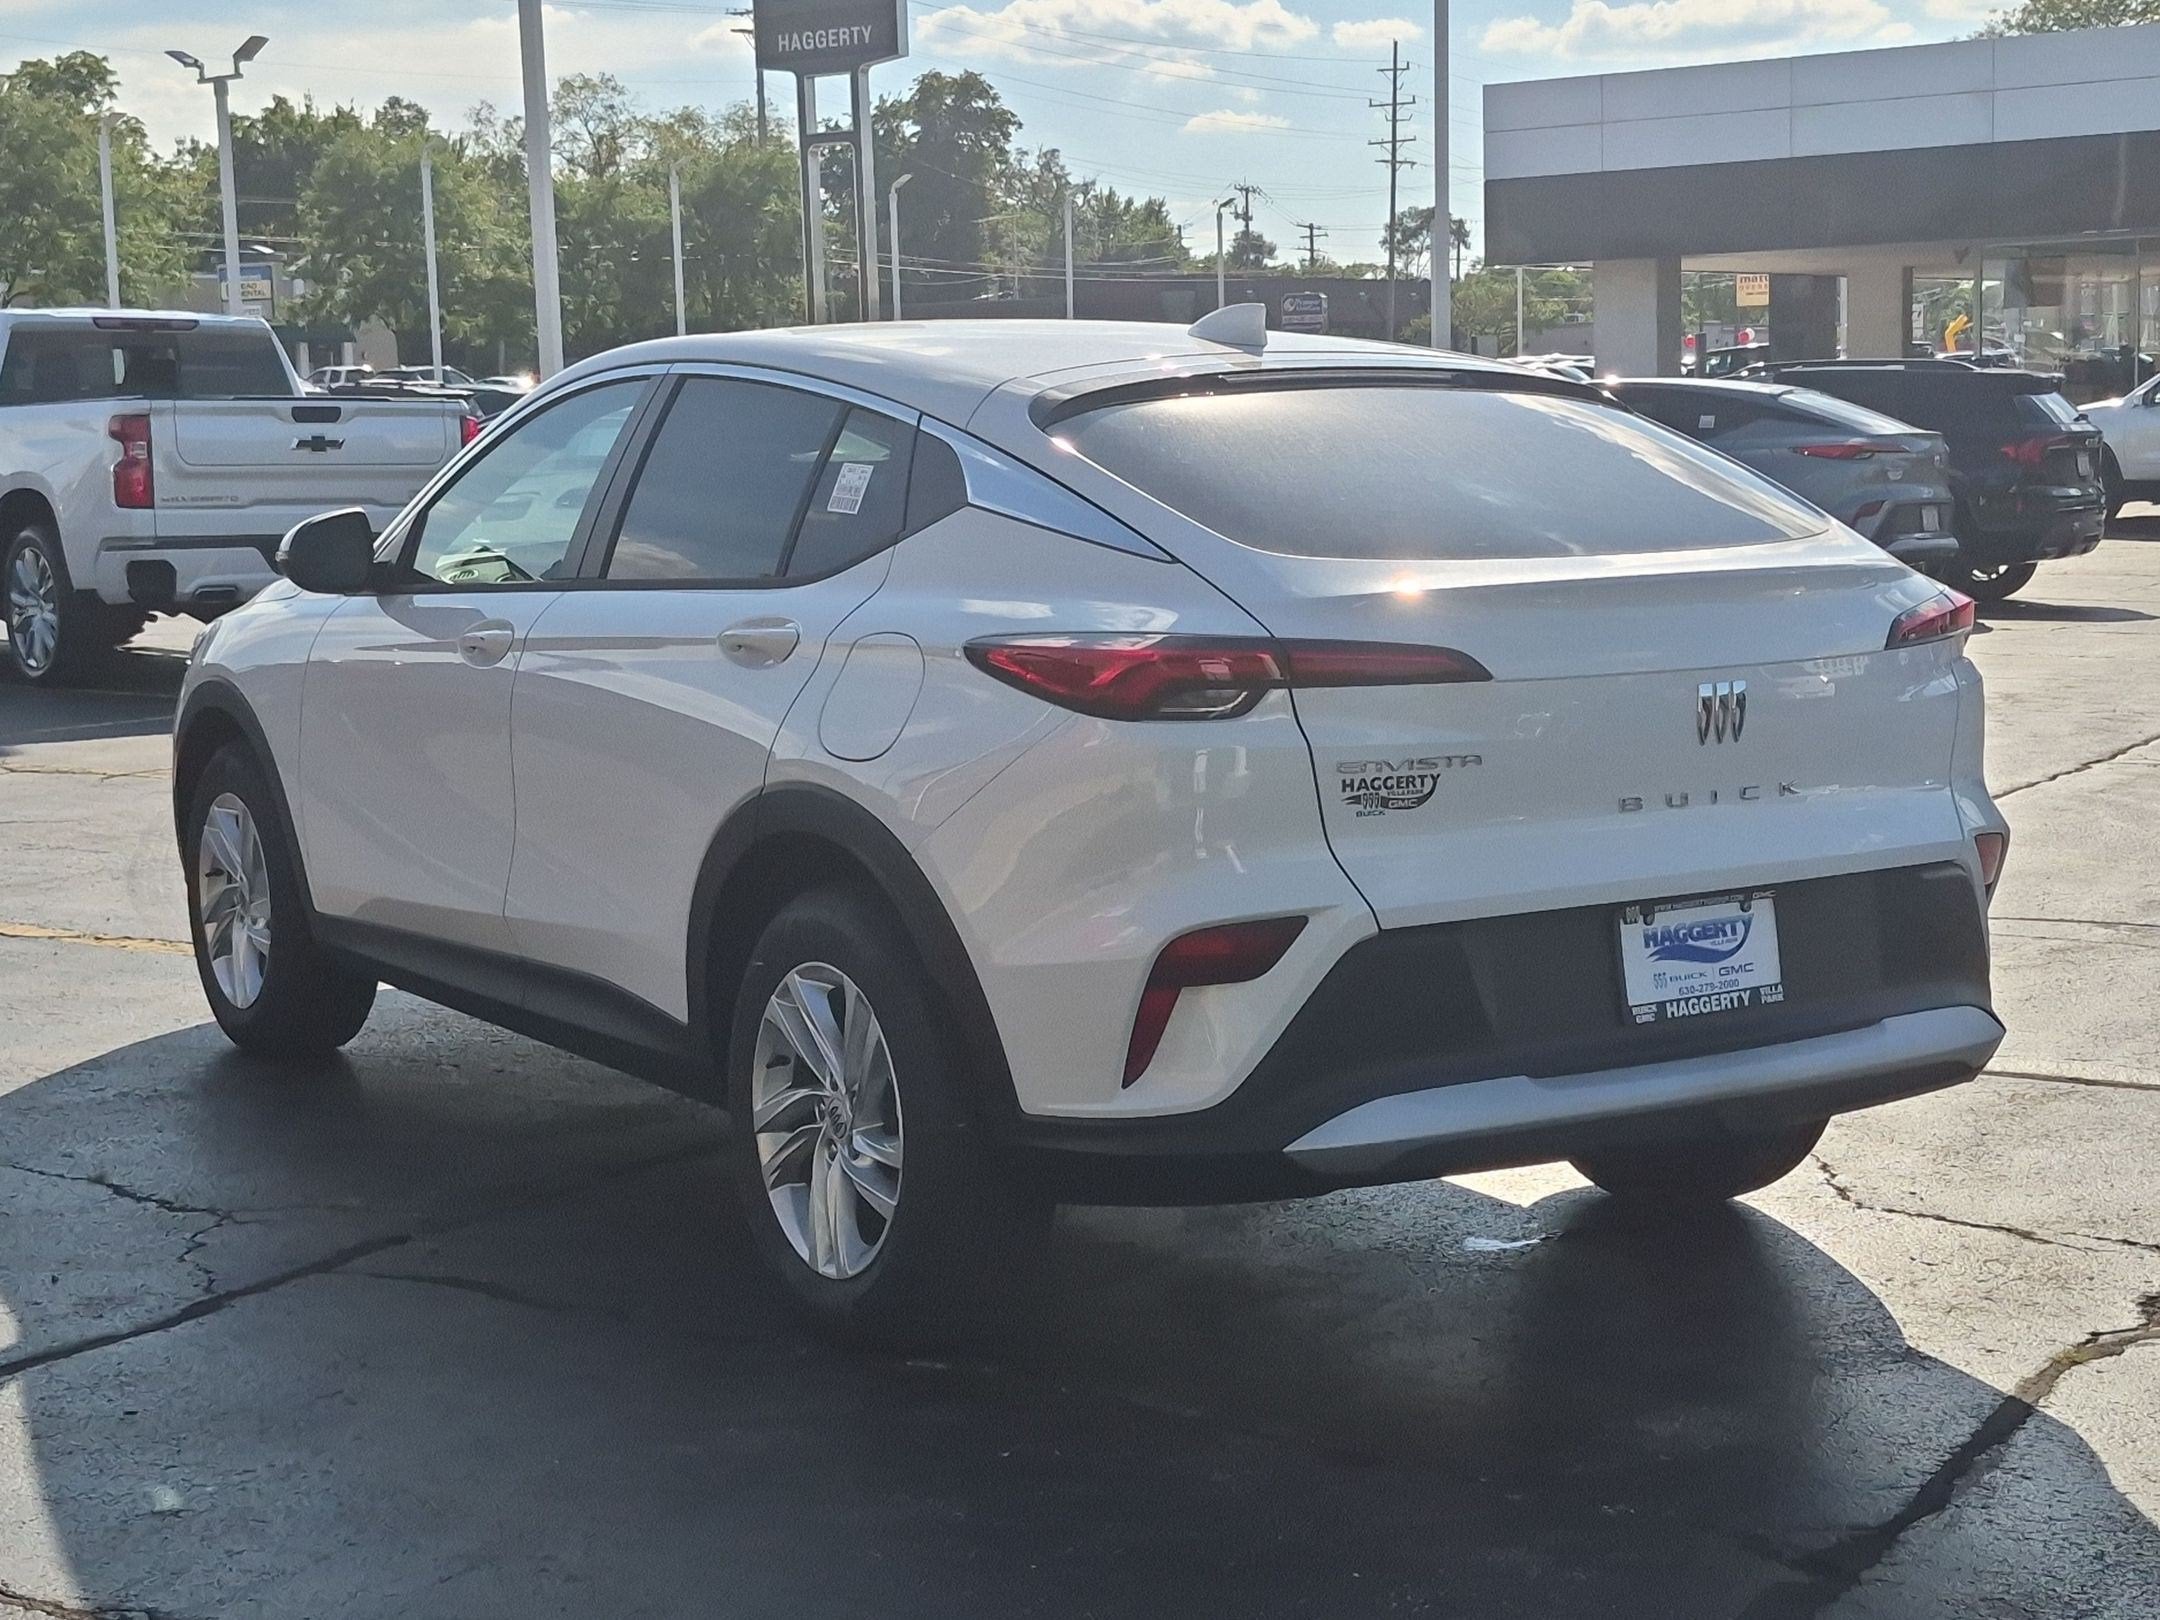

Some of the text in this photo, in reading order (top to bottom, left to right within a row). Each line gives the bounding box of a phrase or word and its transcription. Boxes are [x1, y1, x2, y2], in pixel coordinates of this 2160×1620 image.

[777, 24, 872, 52] HAGGERTY
[1336, 754, 1483, 774] ENVISTA
[1340, 773, 1441, 794] HAGGERTY
[1388, 798, 1418, 808] GMC
[1618, 779, 1801, 813] BUICK
[1642, 912, 1755, 950] HAGGERTY
[1669, 962, 1755, 983] BUICK GMC
[1678, 978, 1740, 997] 630-279-2000
[1666, 989, 1751, 1019] HAGGERTY
